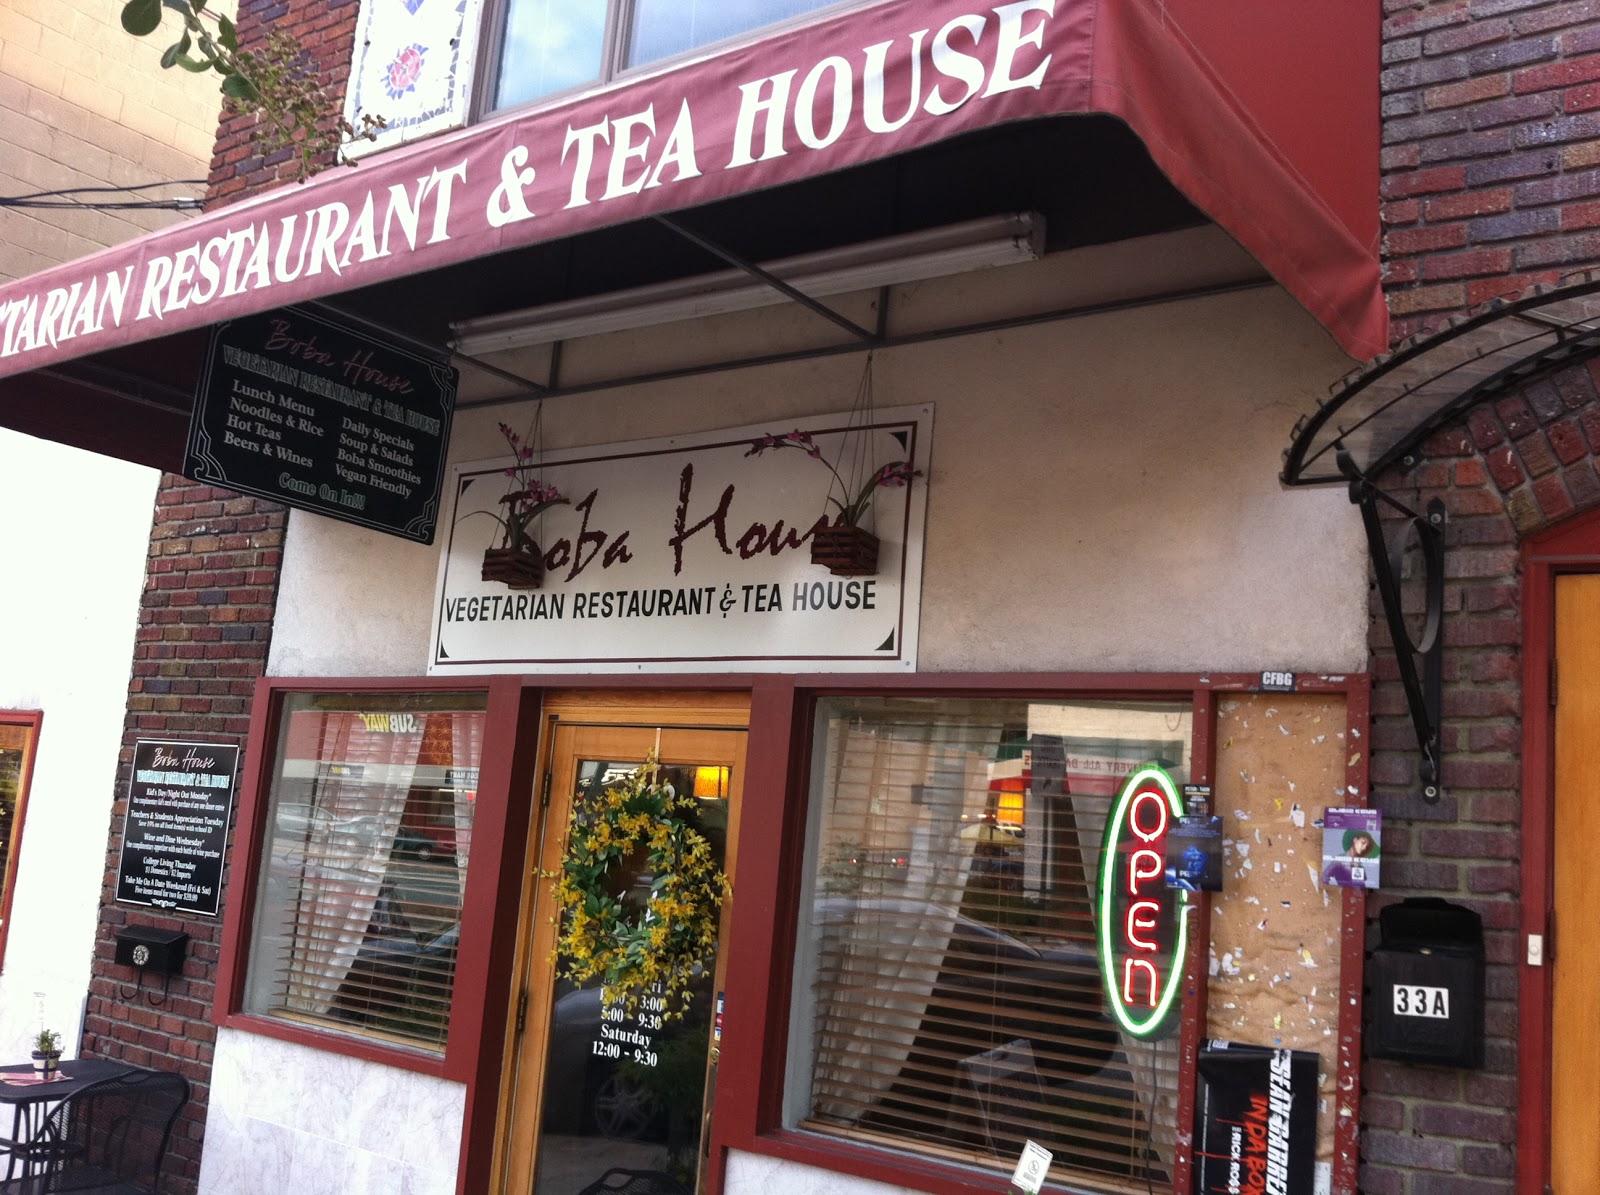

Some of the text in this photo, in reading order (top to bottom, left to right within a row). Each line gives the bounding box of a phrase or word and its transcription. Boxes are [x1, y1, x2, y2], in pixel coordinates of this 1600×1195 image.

[0, 0, 1055, 357] TARIAN RESTAURANT & TEA HOUSE
[265, 319, 414, 394] Boba House
[223, 344, 300, 386] VEGETARIAN
[299, 370, 373, 412] RESTAURANT
[383, 401, 404, 424] TEA
[405, 409, 440, 436] HOUSE
[233, 379, 315, 417] Lunch Menu
[227, 414, 281, 441] Hot Teas
[229, 397, 325, 437] Noodles & Rice
[342, 417, 415, 451] Daily Specials
[224, 431, 313, 468] Beers & Wines
[337, 448, 421, 485] Boba Smoothies
[339, 433, 414, 467] Soup & Salads
[279, 472, 316, 496] Come
[319, 484, 338, 502] On
[335, 464, 411, 499] Vegan Friendly
[669, 463, 844, 576] Hou
[445, 580, 876, 623] VEGETARIAN RESTAURANT & TEA HOUSE
[1262, 671, 1293, 686] CFBG
[152, 747, 215, 772] Boba House
[130, 810, 150, 818] Teachers
[175, 814, 204, 825] Appreciation
[204, 817, 224, 827] Tuesday
[160, 858, 174, 868] Living
[174, 860, 197, 871] Thursday
[1396, 987, 1447, 1017] 33A
[601, 1023, 652, 1049] Saturday
[592, 1040, 621, 1059] 12:00
[634, 1048, 658, 1067] 9:30
[1247, 1095, 1269, 1121] IN
[1265, 1055, 1292, 1195] SEAN GARRE
[1231, 1133, 1243, 1162] RICK
[1246, 1122, 1269, 1153] DA
